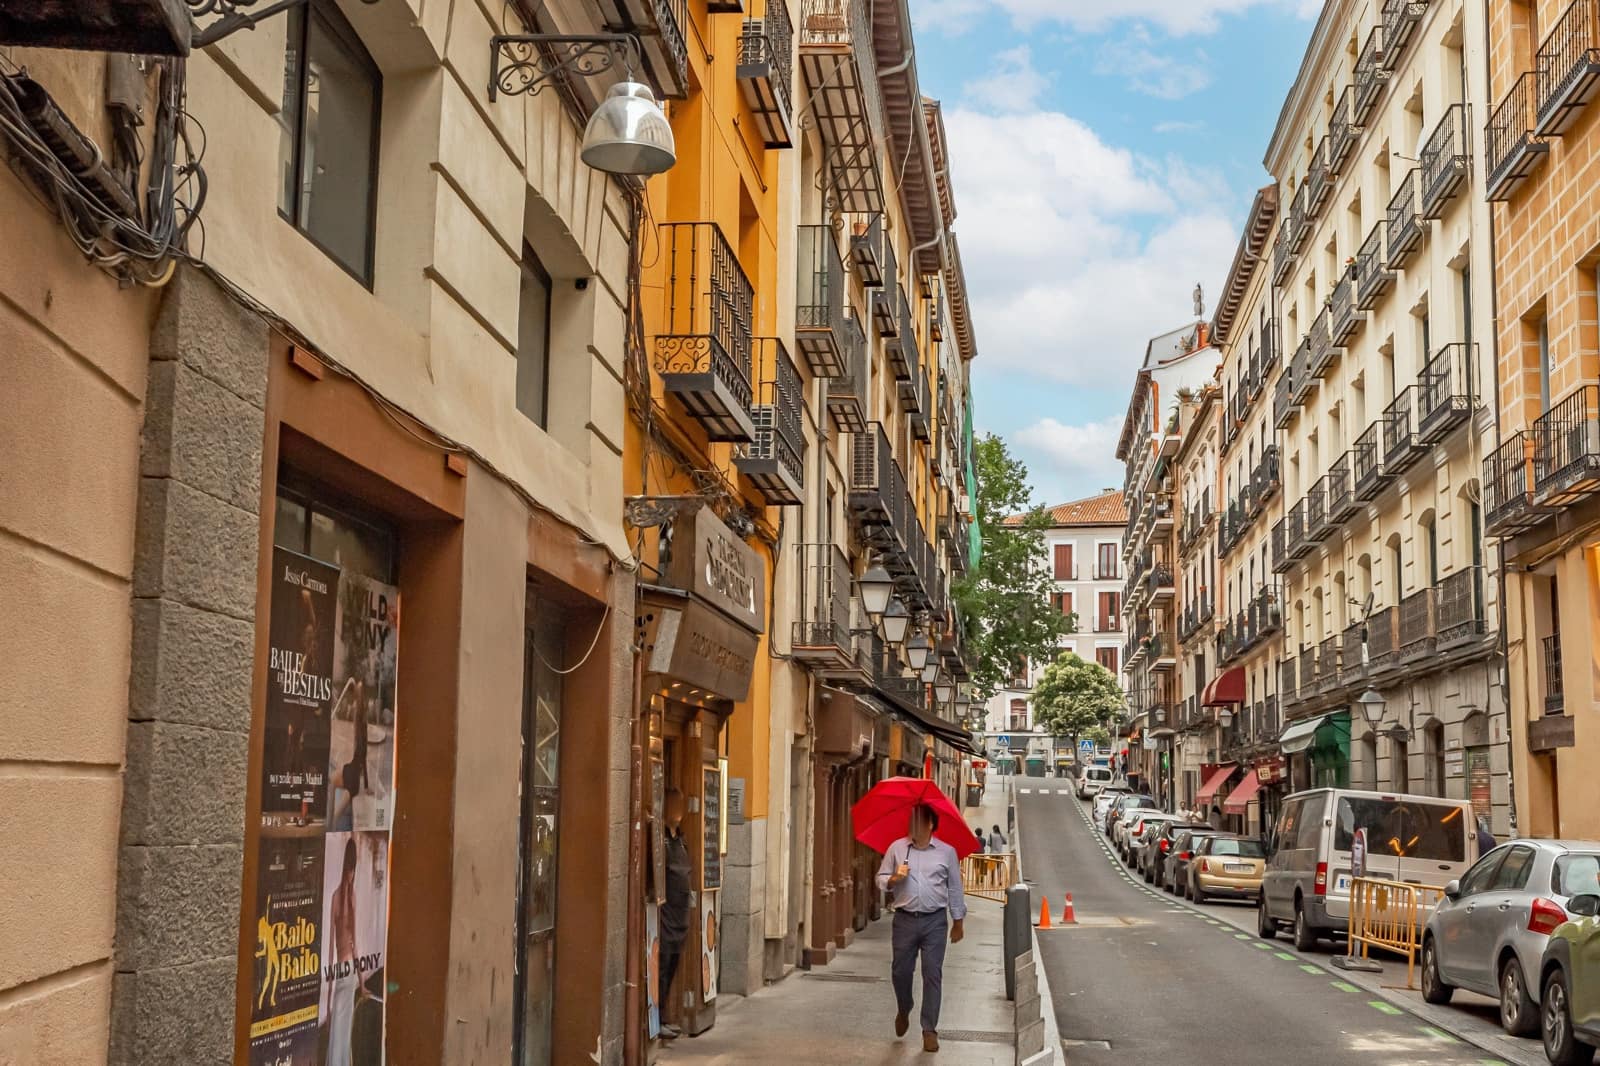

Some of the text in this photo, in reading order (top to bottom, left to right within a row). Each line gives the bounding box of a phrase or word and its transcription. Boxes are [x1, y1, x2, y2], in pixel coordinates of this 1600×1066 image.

[301, 571, 327, 594] Carmona
[270, 647, 303, 673] BAILE
[283, 669, 331, 701] BESTIAS
[272, 916, 315, 951] Bailo
[280, 947, 319, 982] Bailo
[324, 952, 381, 982] WILD PONY
